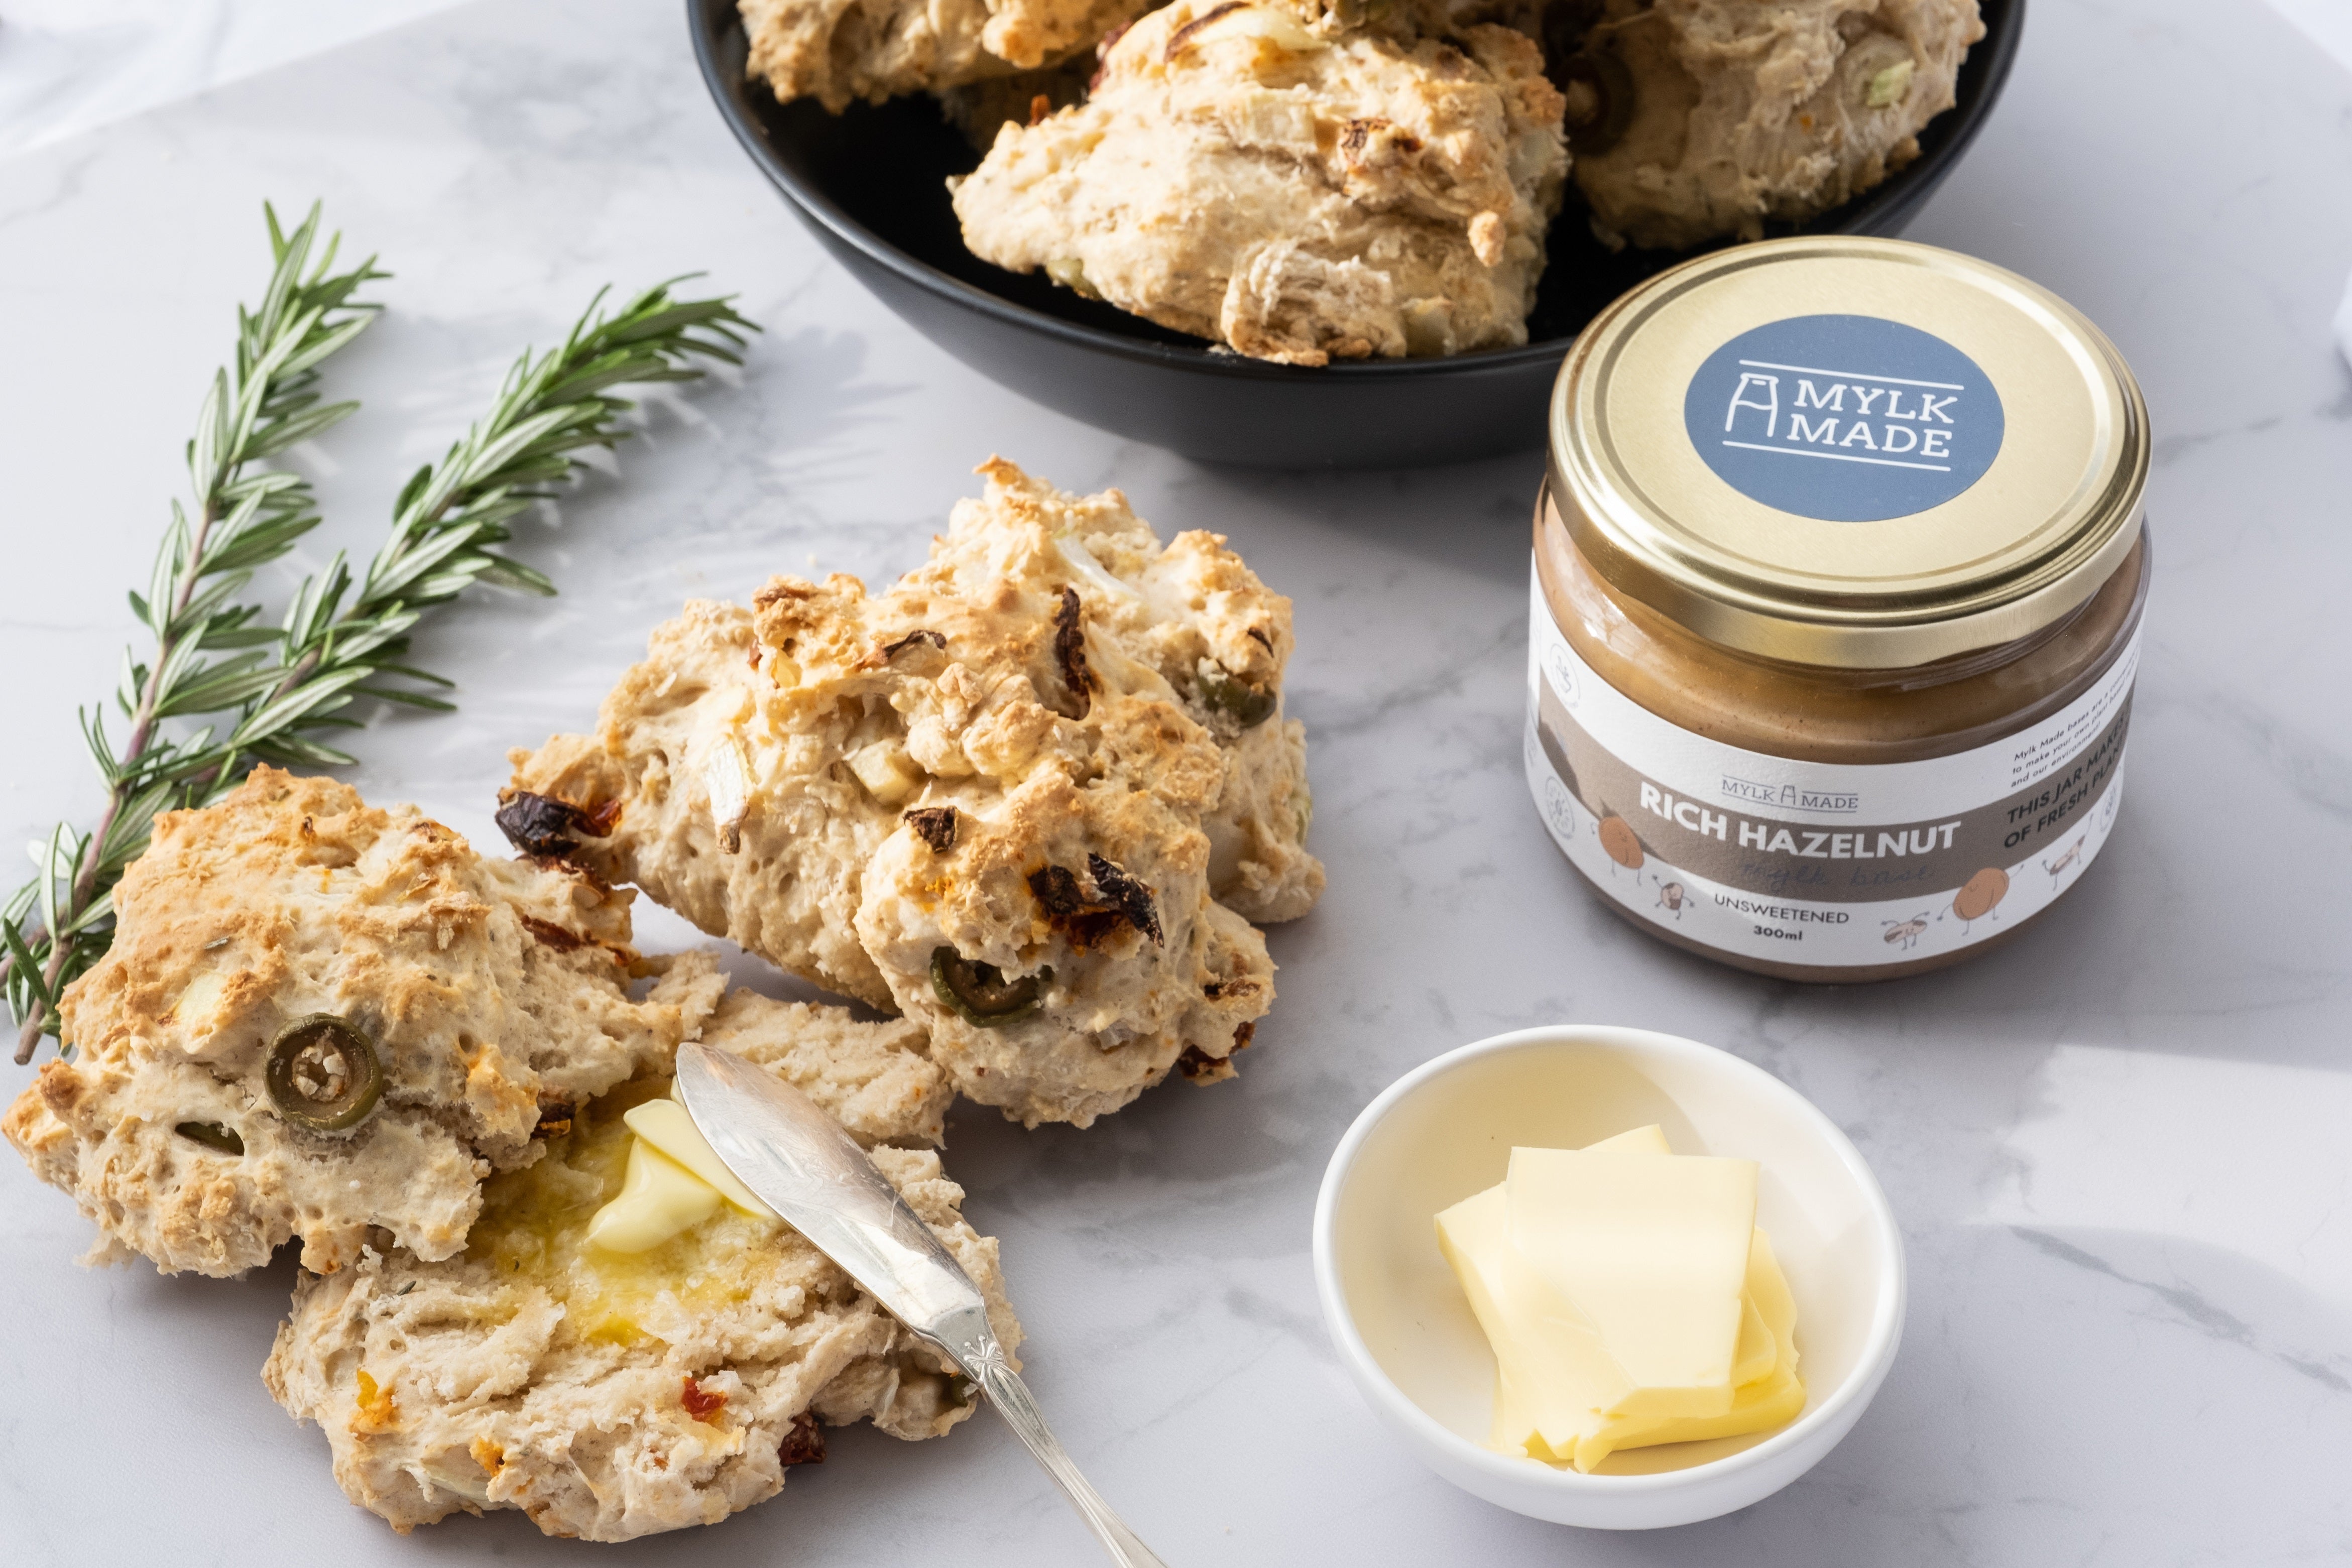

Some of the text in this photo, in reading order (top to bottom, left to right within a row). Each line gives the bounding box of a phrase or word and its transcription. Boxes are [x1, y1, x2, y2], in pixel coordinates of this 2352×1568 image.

[1794, 379, 1958, 424] MYLK
[1787, 413, 1953, 458] MADE
[2013, 766, 2022, 774] to
[2026, 752, 2050, 768] make
[2053, 736, 2071, 755] your
[2074, 722, 2089, 738] own
[2091, 702, 2108, 725] plant
[2014, 745, 2036, 761] Mylk
[2040, 731, 2064, 749] Made
[2067, 711, 2089, 732] bases
[2091, 698, 2102, 712] are
[1722, 779, 1858, 810] MYLK MADE
[2007, 790, 2050, 824] THIS
[2052, 767, 2082, 803] JAR
[2011, 772, 2029, 787] and
[2032, 764, 2049, 777] our
[1640, 781, 1962, 859] RICH HAZELNUT
[2004, 824, 2032, 849] OF
[2037, 782, 2088, 833] FRESH
[1714, 893, 1849, 924] UNSWEETENED
[1753, 925, 1803, 941] 300ml
